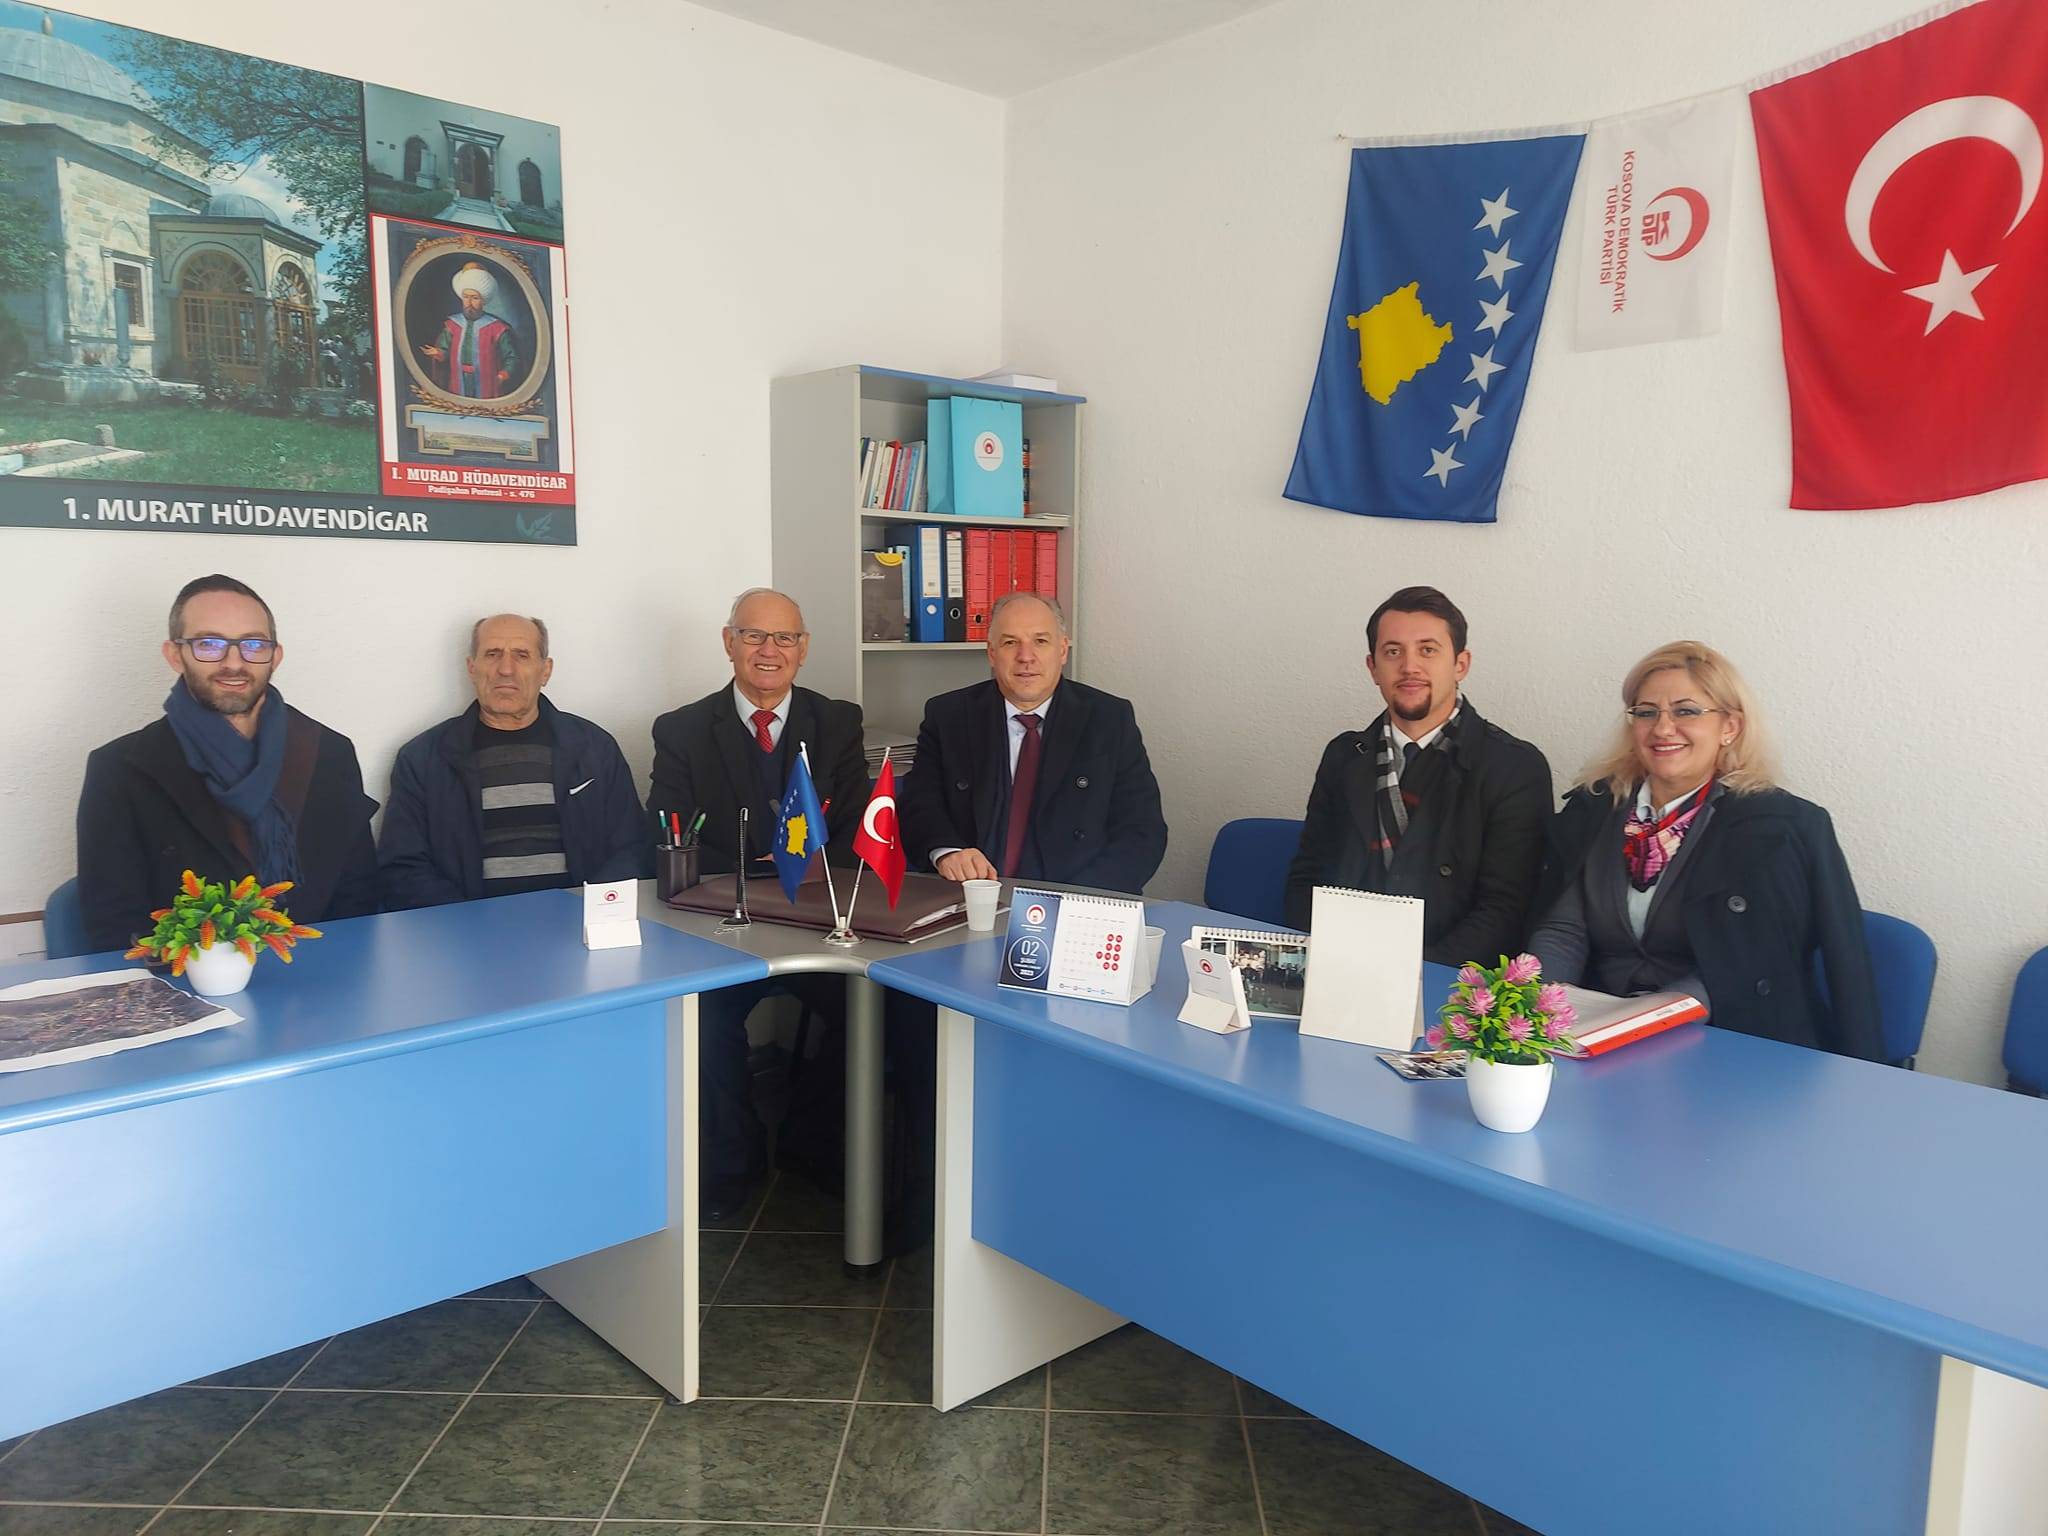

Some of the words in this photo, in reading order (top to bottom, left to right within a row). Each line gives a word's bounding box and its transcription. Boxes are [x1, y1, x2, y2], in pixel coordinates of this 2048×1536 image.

[1621, 150, 1635, 213] KOSOVA
[1604, 185, 1618, 226] TÜRK
[1599, 229, 1616, 285] PARTİSİ
[1612, 217, 1631, 313] DEMOKRATİK
[407, 468, 458, 482] MURAD
[462, 470, 567, 489] HÜDAVENDİGAR
[63, 498, 90, 520] 1.
[97, 498, 205, 524] MURAT
[212, 499, 428, 532] HÜDAVENDİGAR
[1021, 940, 1040, 957] 02
